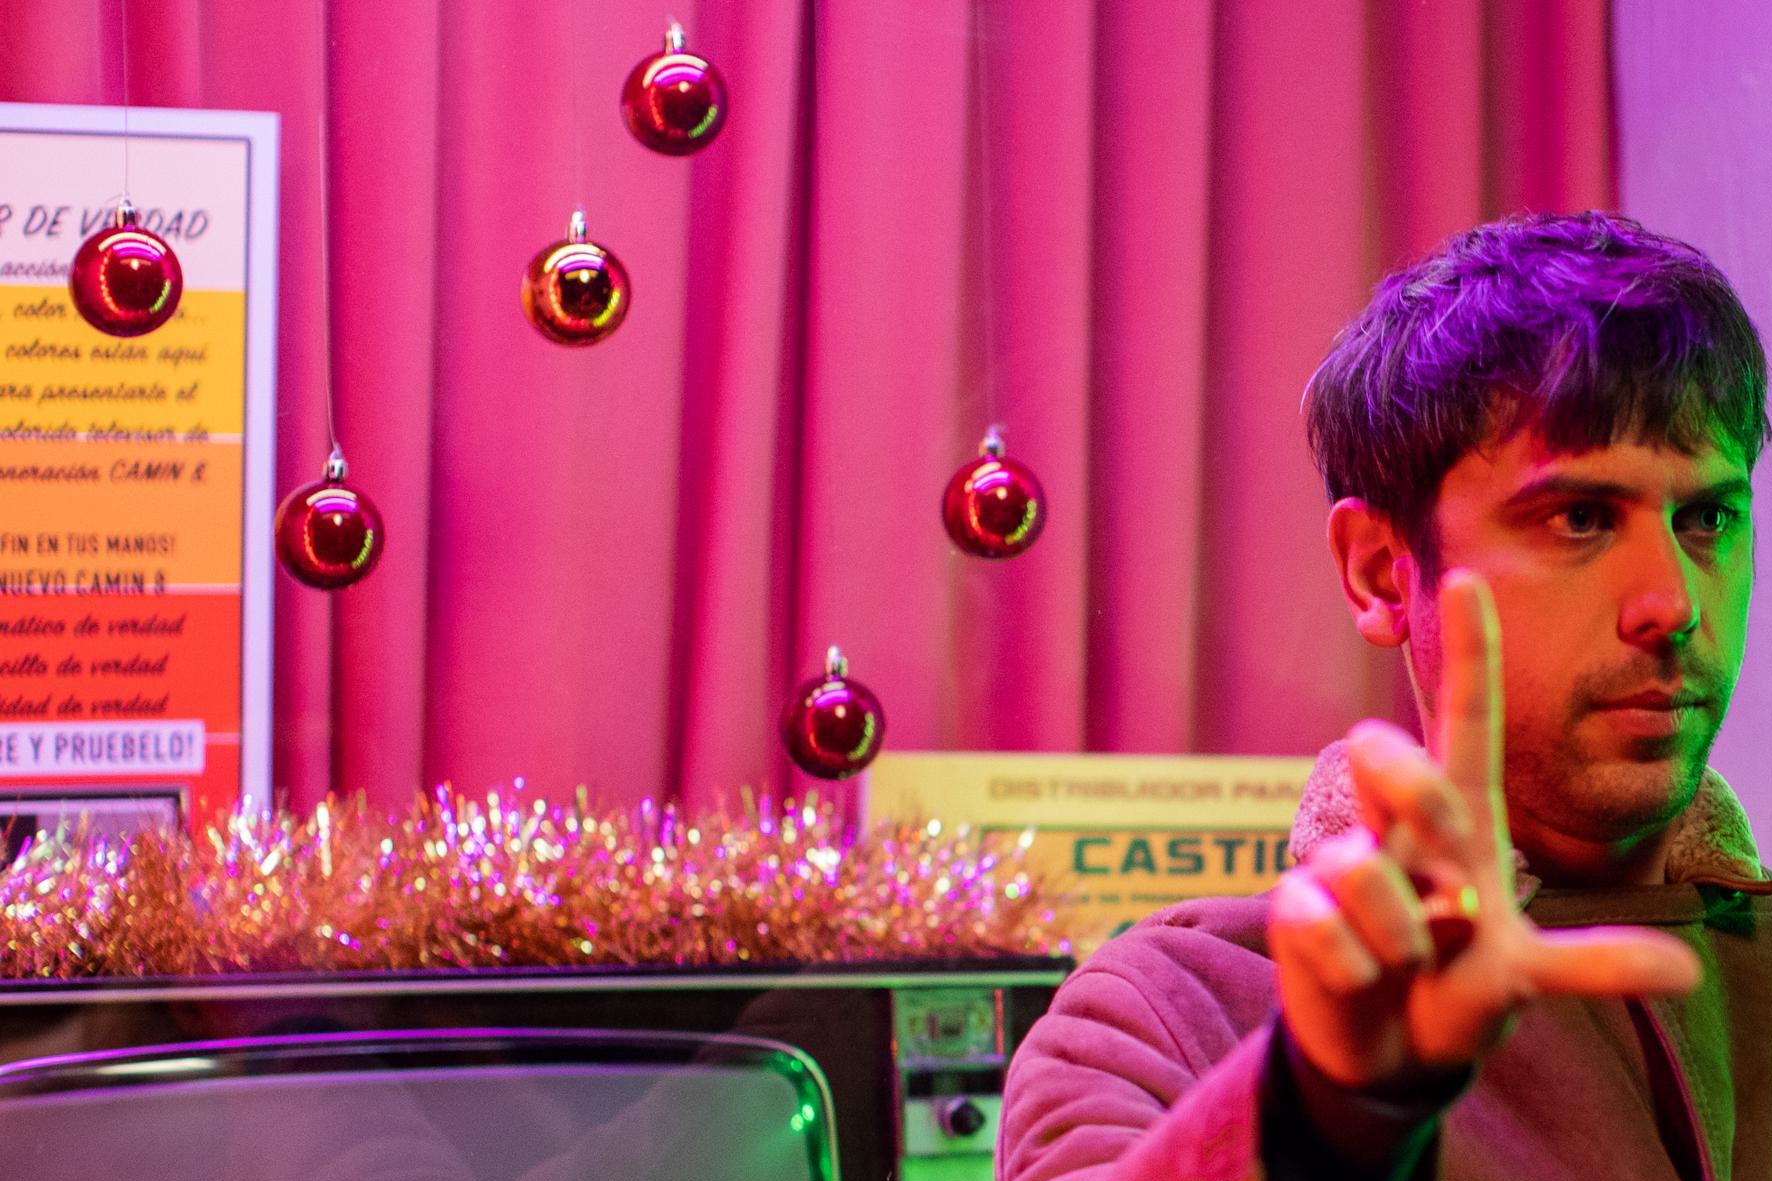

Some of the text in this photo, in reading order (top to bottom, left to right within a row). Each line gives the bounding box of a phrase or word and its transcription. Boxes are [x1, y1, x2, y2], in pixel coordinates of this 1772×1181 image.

[23, 204, 71, 237] DE
[79, 206, 210, 239] VEDAD
[5, 340, 80, 360] colores
[36, 533, 59, 554] EN
[67, 533, 99, 554] TUS
[75, 571, 145, 595] CAMIN
[74, 615, 100, 635] de
[107, 613, 187, 635] verdad
[56, 655, 82, 675] de
[91, 653, 169, 675] verdad
[57, 695, 84, 715] de
[91, 693, 169, 715] verdad
[30, 734, 43, 762] Y
